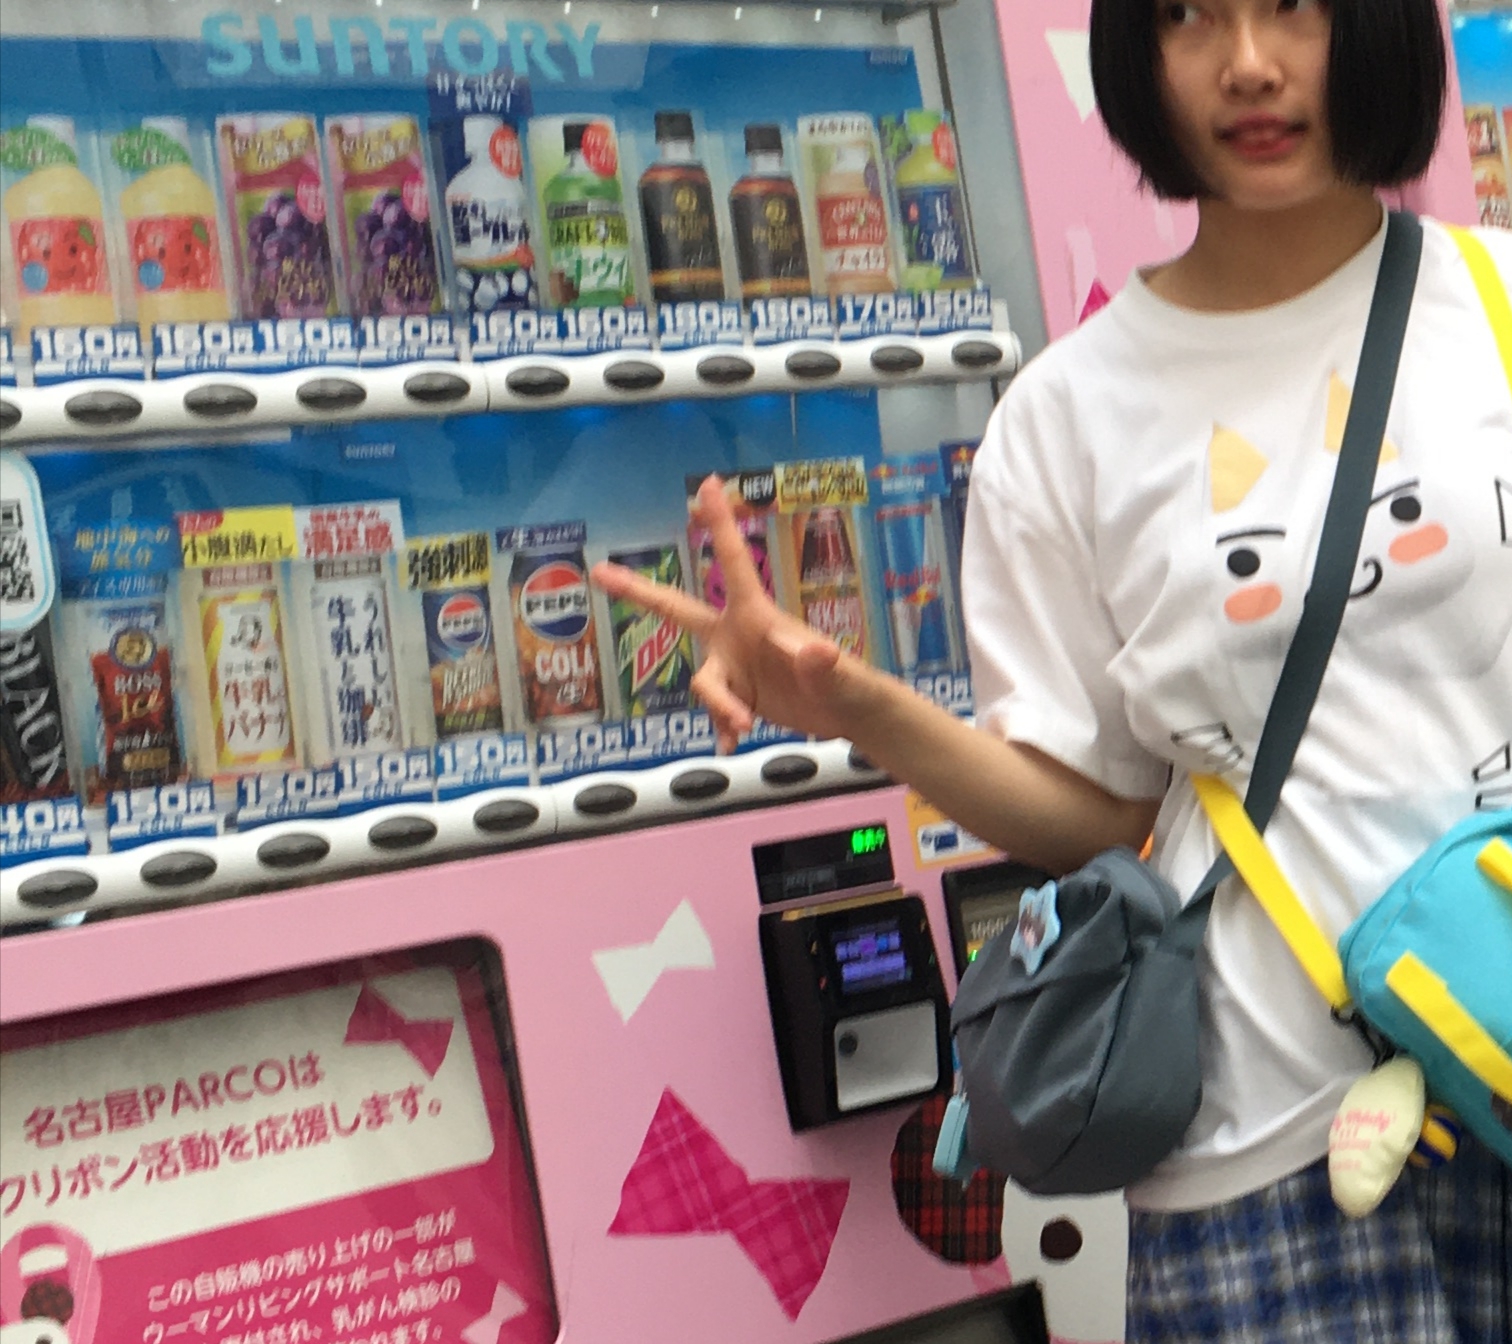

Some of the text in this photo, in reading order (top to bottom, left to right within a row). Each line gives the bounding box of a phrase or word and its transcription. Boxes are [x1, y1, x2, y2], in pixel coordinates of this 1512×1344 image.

[204, 10, 604, 86] SUNTORY
[742, 474, 774, 502] NEW
[534, 645, 597, 685] COLA
[23, 1049, 327, 1152] 名古屋PARCOは
[0, 1079, 444, 1217] クリボン活動を応援します。
